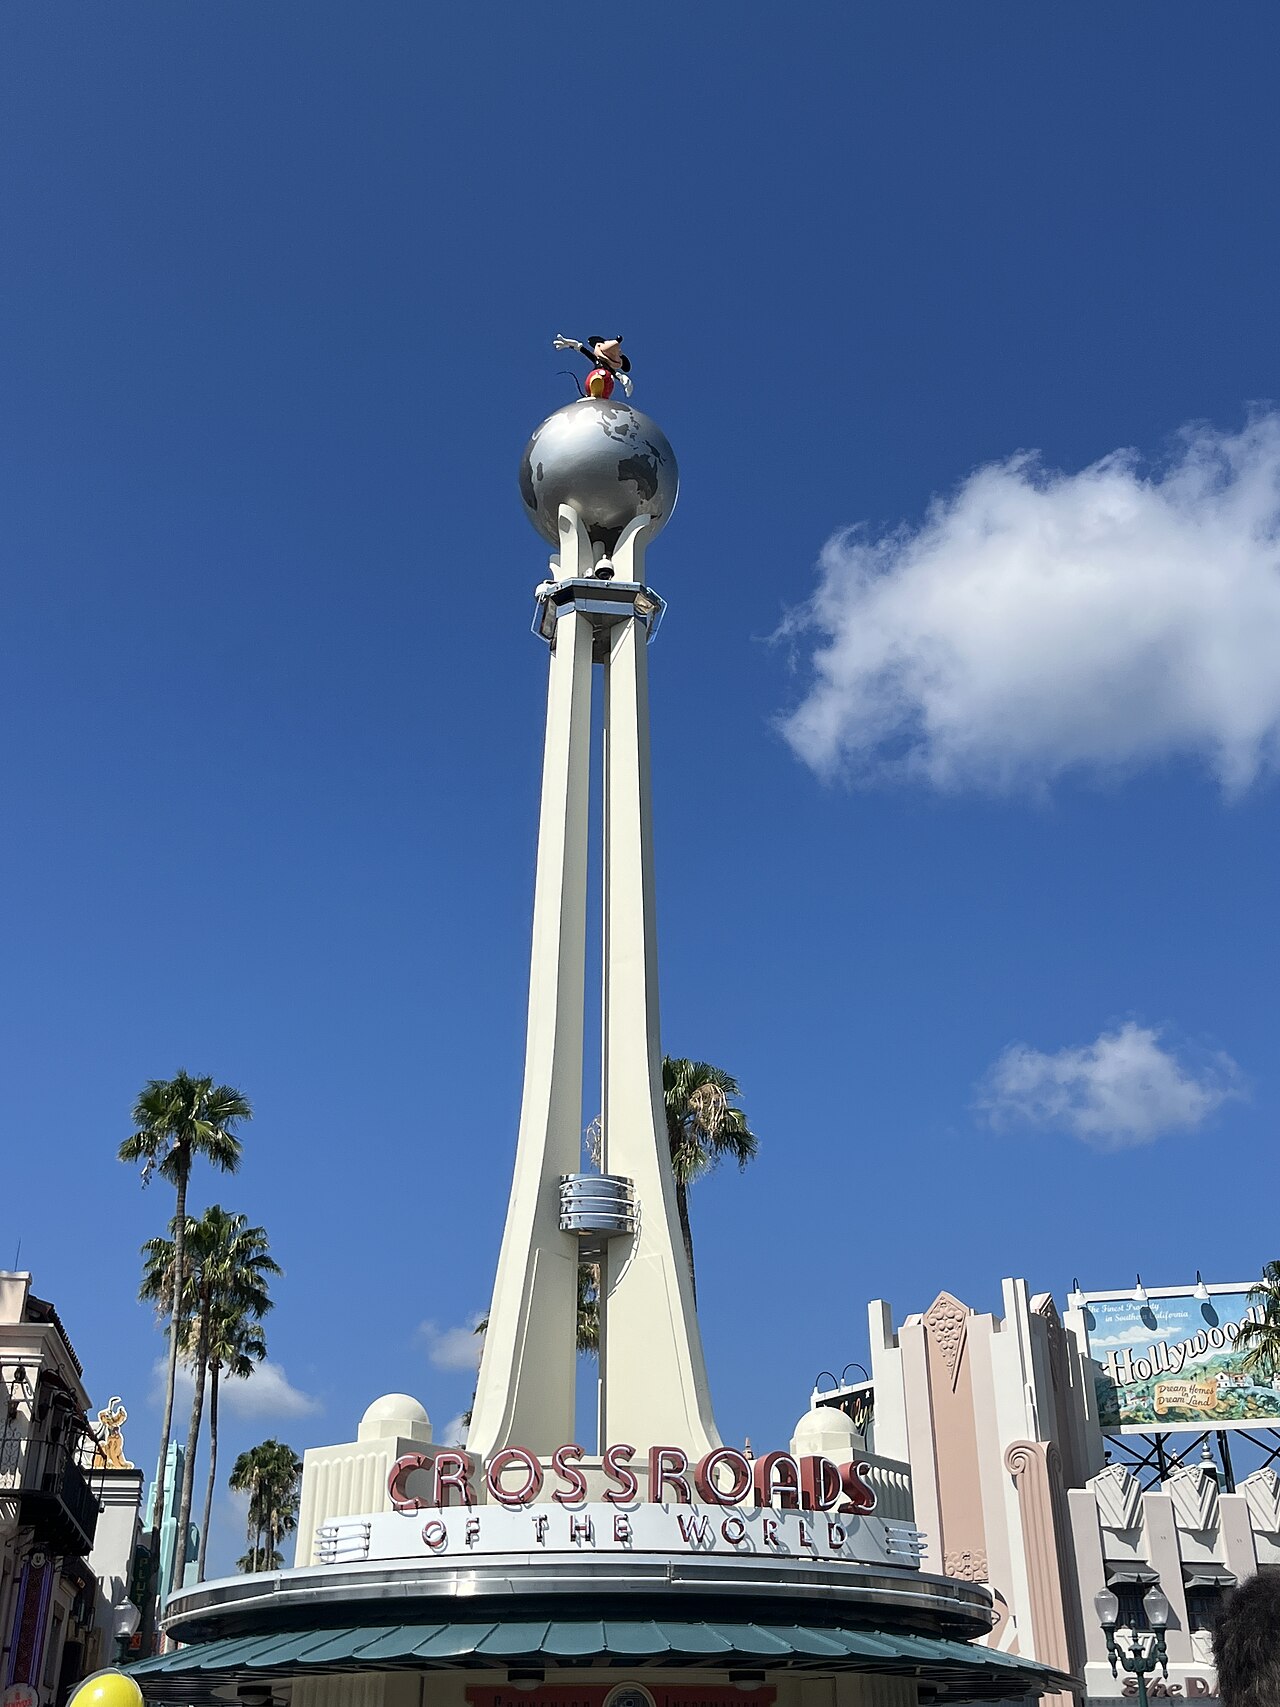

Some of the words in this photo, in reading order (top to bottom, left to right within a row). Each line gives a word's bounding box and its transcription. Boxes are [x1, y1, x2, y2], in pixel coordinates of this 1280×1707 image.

[1088, 1305, 1100, 1313] The
[1101, 1304, 1124, 1313] Finest
[1157, 1384, 1187, 1394] Dream
[1189, 1384, 1214, 1395] Homes
[1157, 1396, 1185, 1405] Dream
[1186, 1395, 1211, 1407] Land
[387, 1444, 878, 1515] CROSSROADS
[421, 1516, 480, 1548] OF
[532, 1513, 631, 1543] THE
[677, 1514, 848, 1549] WORLD
[1121, 1677, 1184, 1698] The
